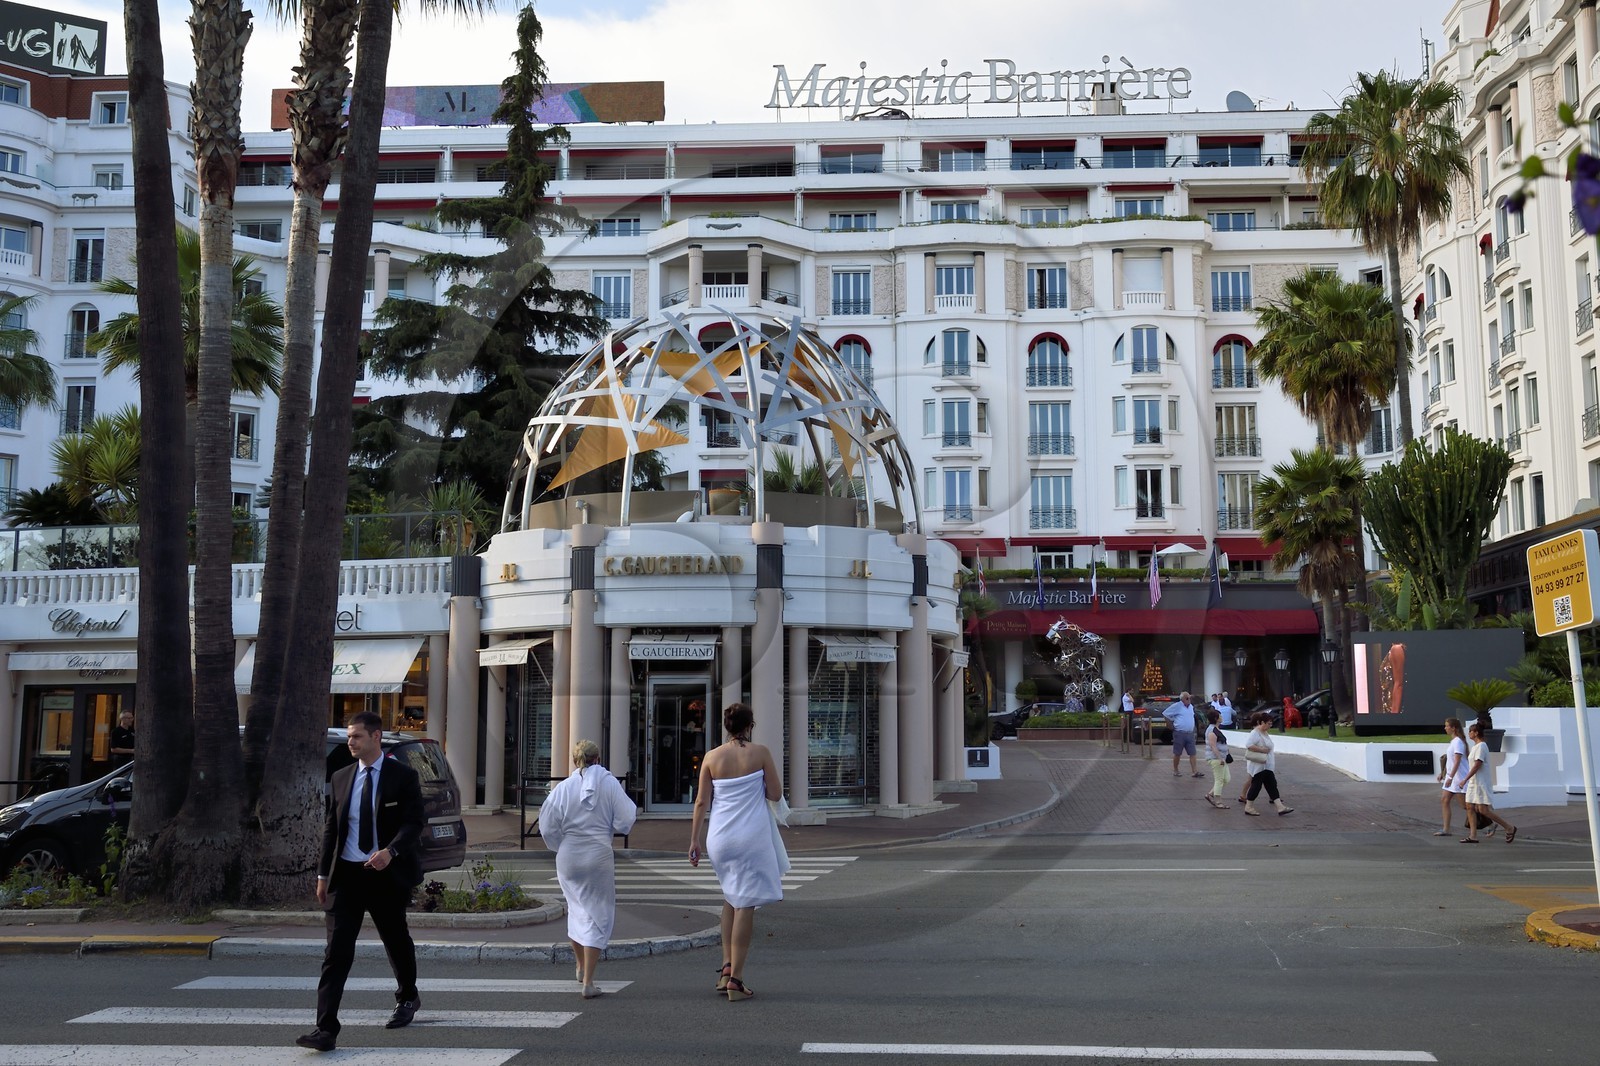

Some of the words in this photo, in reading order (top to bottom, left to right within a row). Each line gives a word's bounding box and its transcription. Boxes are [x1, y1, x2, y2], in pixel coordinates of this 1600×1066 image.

[765, 59, 972, 121] Majestic
[984, 54, 1192, 104] Barrière
[1534, 548, 1551, 559] TAXI
[1551, 538, 1579, 554] CANNES
[1533, 571, 1551, 581] STATION
[1562, 561, 1584, 572] MAJESTIC
[1535, 584, 1544, 596] 04
[1545, 581, 1554, 593] 93
[1555, 578, 1564, 590] 99
[1565, 575, 1574, 587] 27
[1576, 571, 1585, 583] 27
[1069, 590, 1126, 604] Barière
[48, 608, 129, 637] Chopard
[66, 655, 107, 669] Chopard
[642, 647, 713, 657] GAUCHERAND
